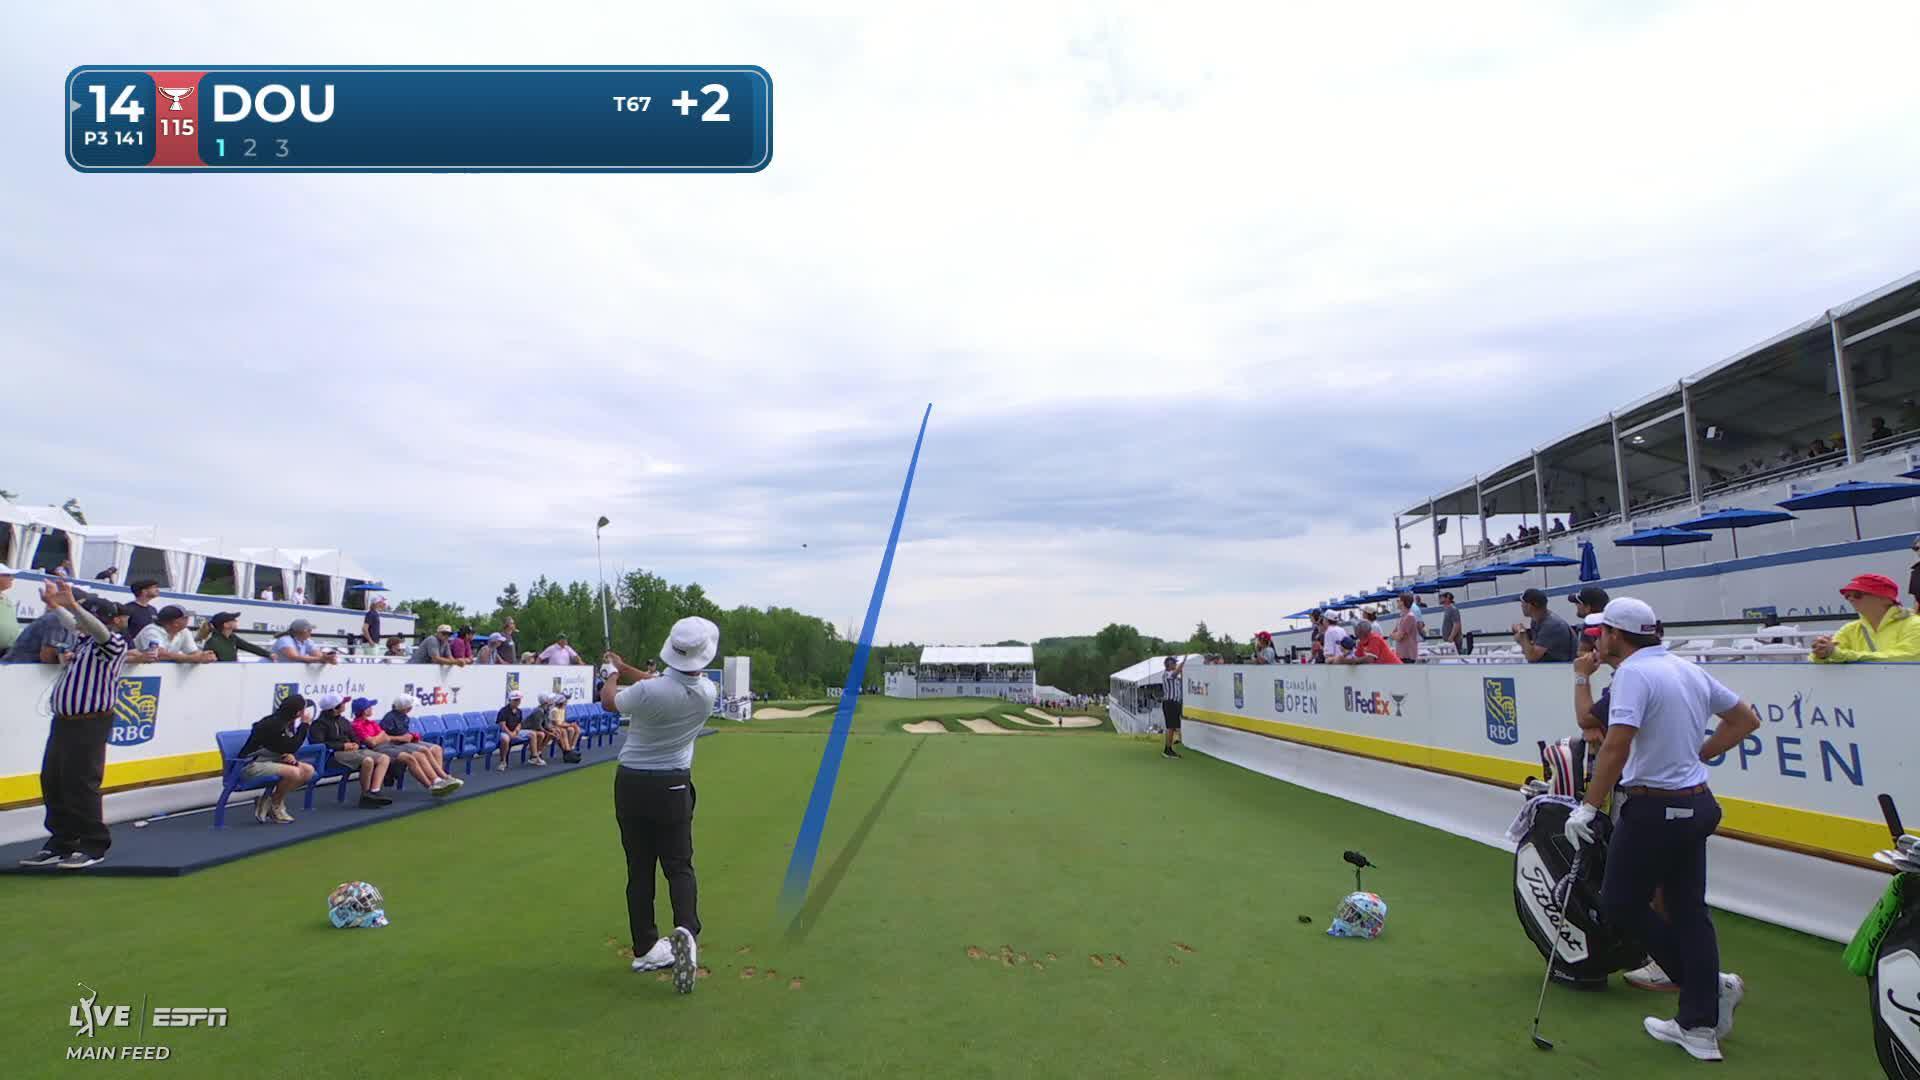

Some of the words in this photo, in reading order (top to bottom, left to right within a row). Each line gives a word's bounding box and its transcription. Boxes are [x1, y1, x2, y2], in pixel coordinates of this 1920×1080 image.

[1286, 694, 1318, 715] OPEN
[1354, 690, 1390, 715] FedEx
[111, 724, 152, 742] RBC
[1489, 724, 1516, 741] RBC
